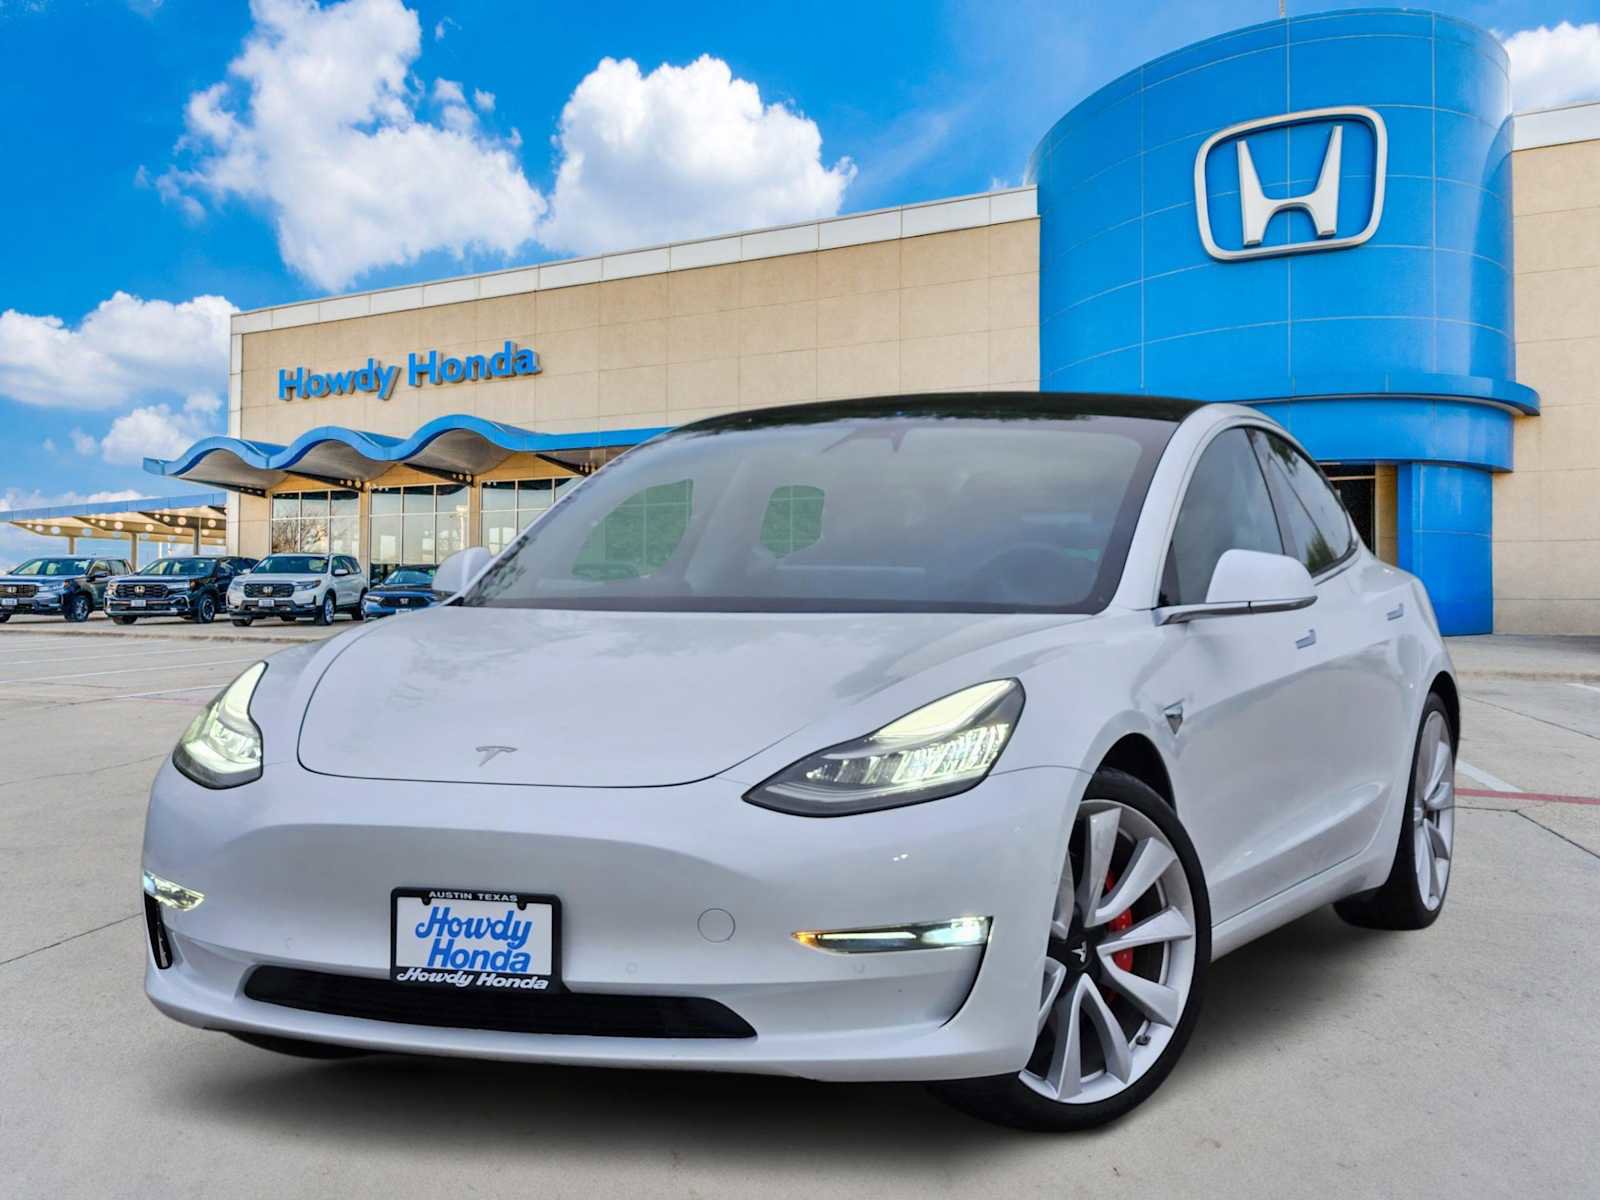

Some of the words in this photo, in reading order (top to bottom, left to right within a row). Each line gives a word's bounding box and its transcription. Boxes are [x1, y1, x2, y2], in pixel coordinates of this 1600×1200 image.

[278, 358, 401, 401] Howdy
[407, 340, 541, 388] Honda
[429, 891, 473, 900] AUSTIN
[478, 893, 518, 902] TEXAS
[415, 906, 533, 950] Howdy
[427, 938, 531, 973] Honda
[396, 967, 474, 987] Howdy
[476, 973, 549, 990] Honda
